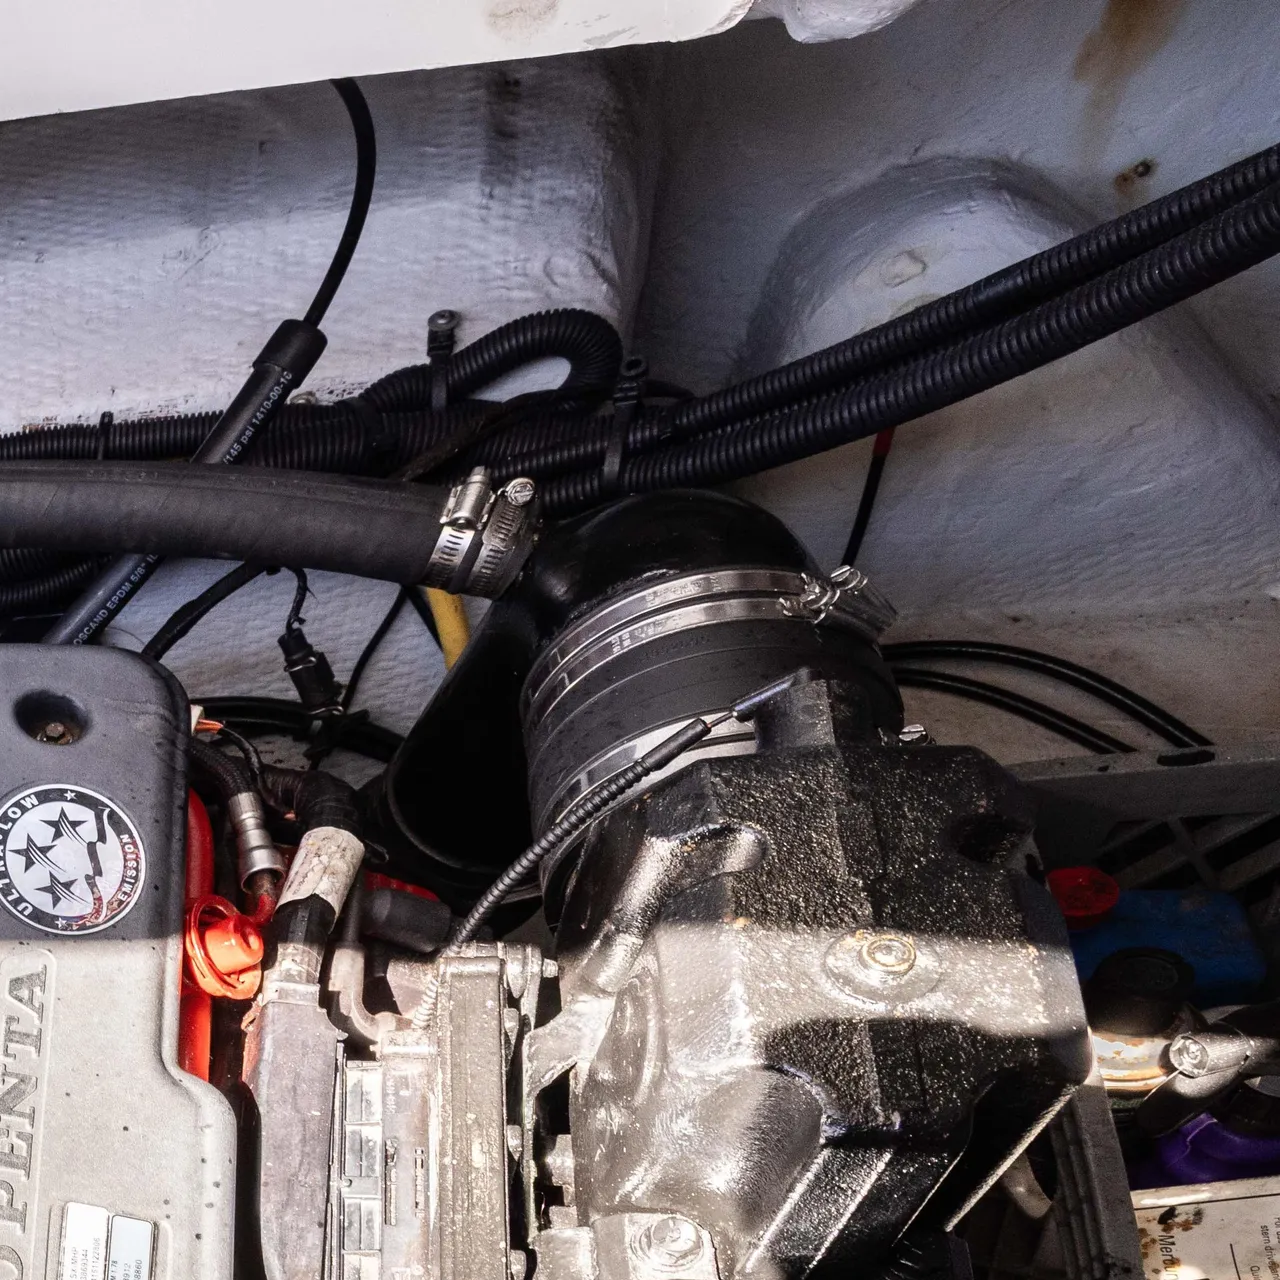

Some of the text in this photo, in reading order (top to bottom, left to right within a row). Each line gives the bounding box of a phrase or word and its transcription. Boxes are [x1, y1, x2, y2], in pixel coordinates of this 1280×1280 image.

[241, 425, 255, 444] psi
[106, 582, 133, 610] EPDM
[130, 563, 145, 582] 5/8"
[117, 833, 136, 901] EMISSION
[1260, 1225, 1271, 1248] stern
